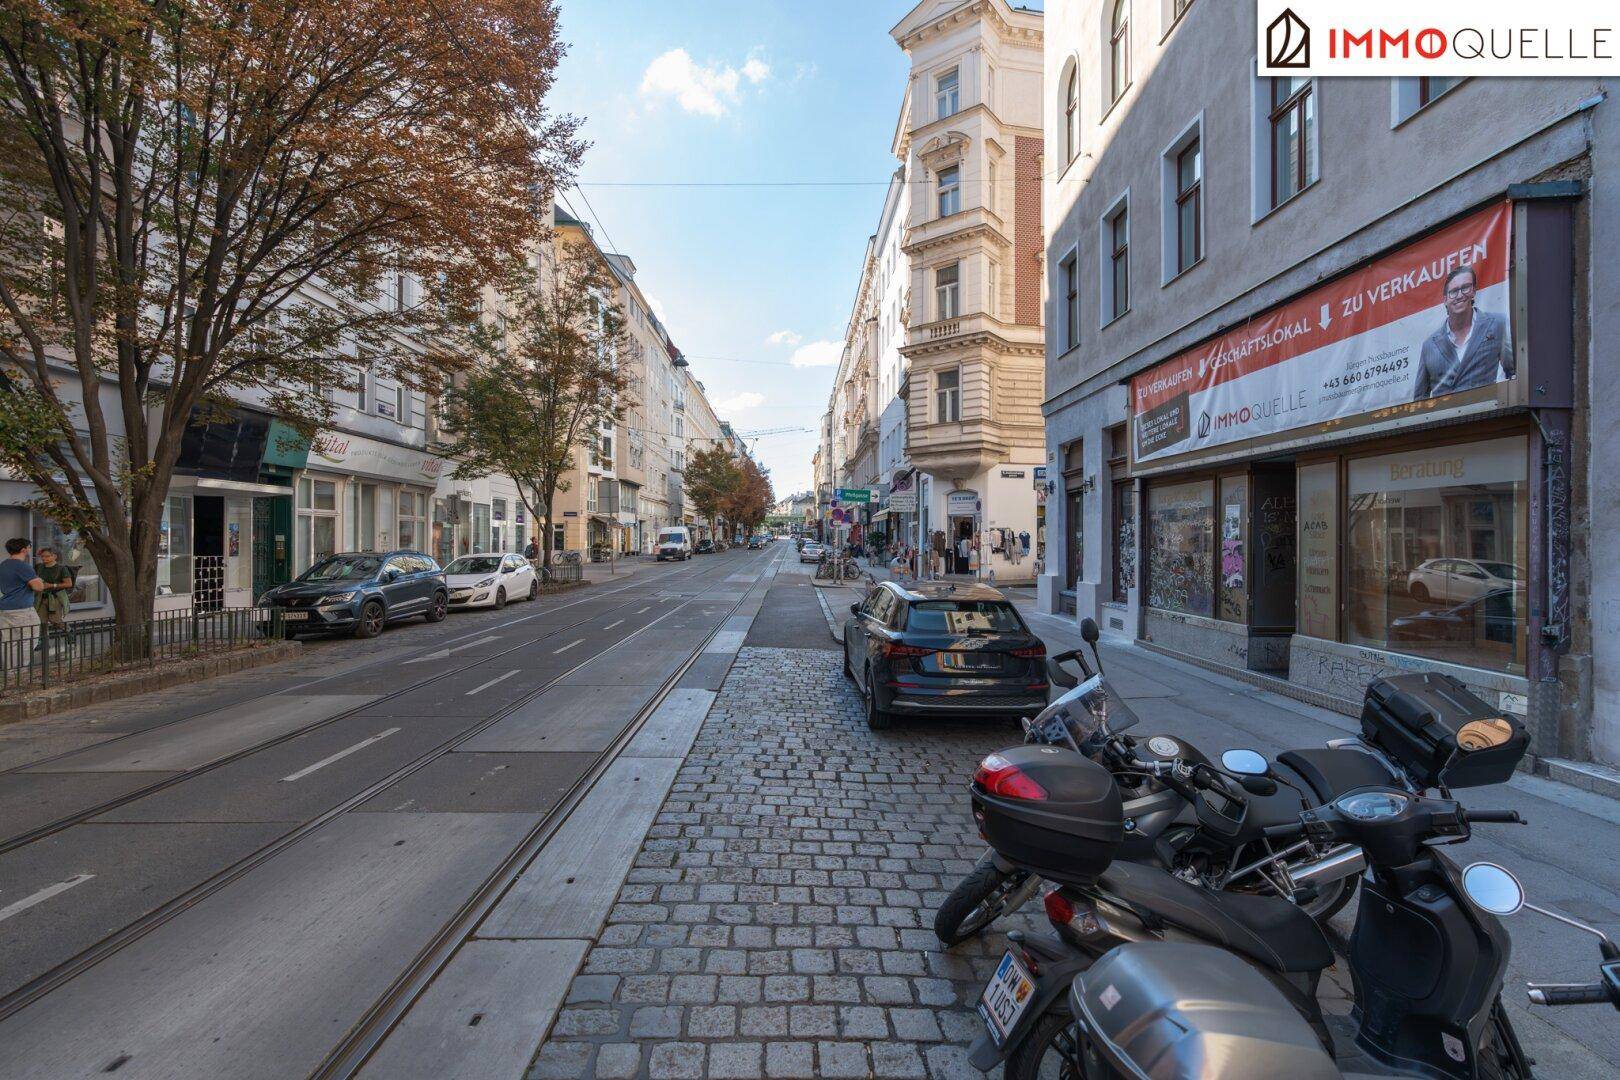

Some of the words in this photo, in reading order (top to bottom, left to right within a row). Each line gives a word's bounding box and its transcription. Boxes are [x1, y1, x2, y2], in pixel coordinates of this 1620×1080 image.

[1342, 293, 1363, 318] ZU
[1367, 239, 1488, 305] VERKAUFEN
[1210, 318, 1311, 370] GESCHÄFTSLOKAL
[1137, 388, 1148, 400] ZU
[1148, 367, 1193, 394] VERKAUFEN
[1323, 377, 1340, 390] +43
[1343, 371, 1361, 385] 660
[1364, 357, 1409, 379] 6794493
[1214, 390, 1307, 430] IMMOQUELLE
[320, 435, 350, 456] vital
[421, 458, 442, 473] vital
[1389, 457, 1465, 481] Beratung
[1303, 520, 1328, 532] ACAB
